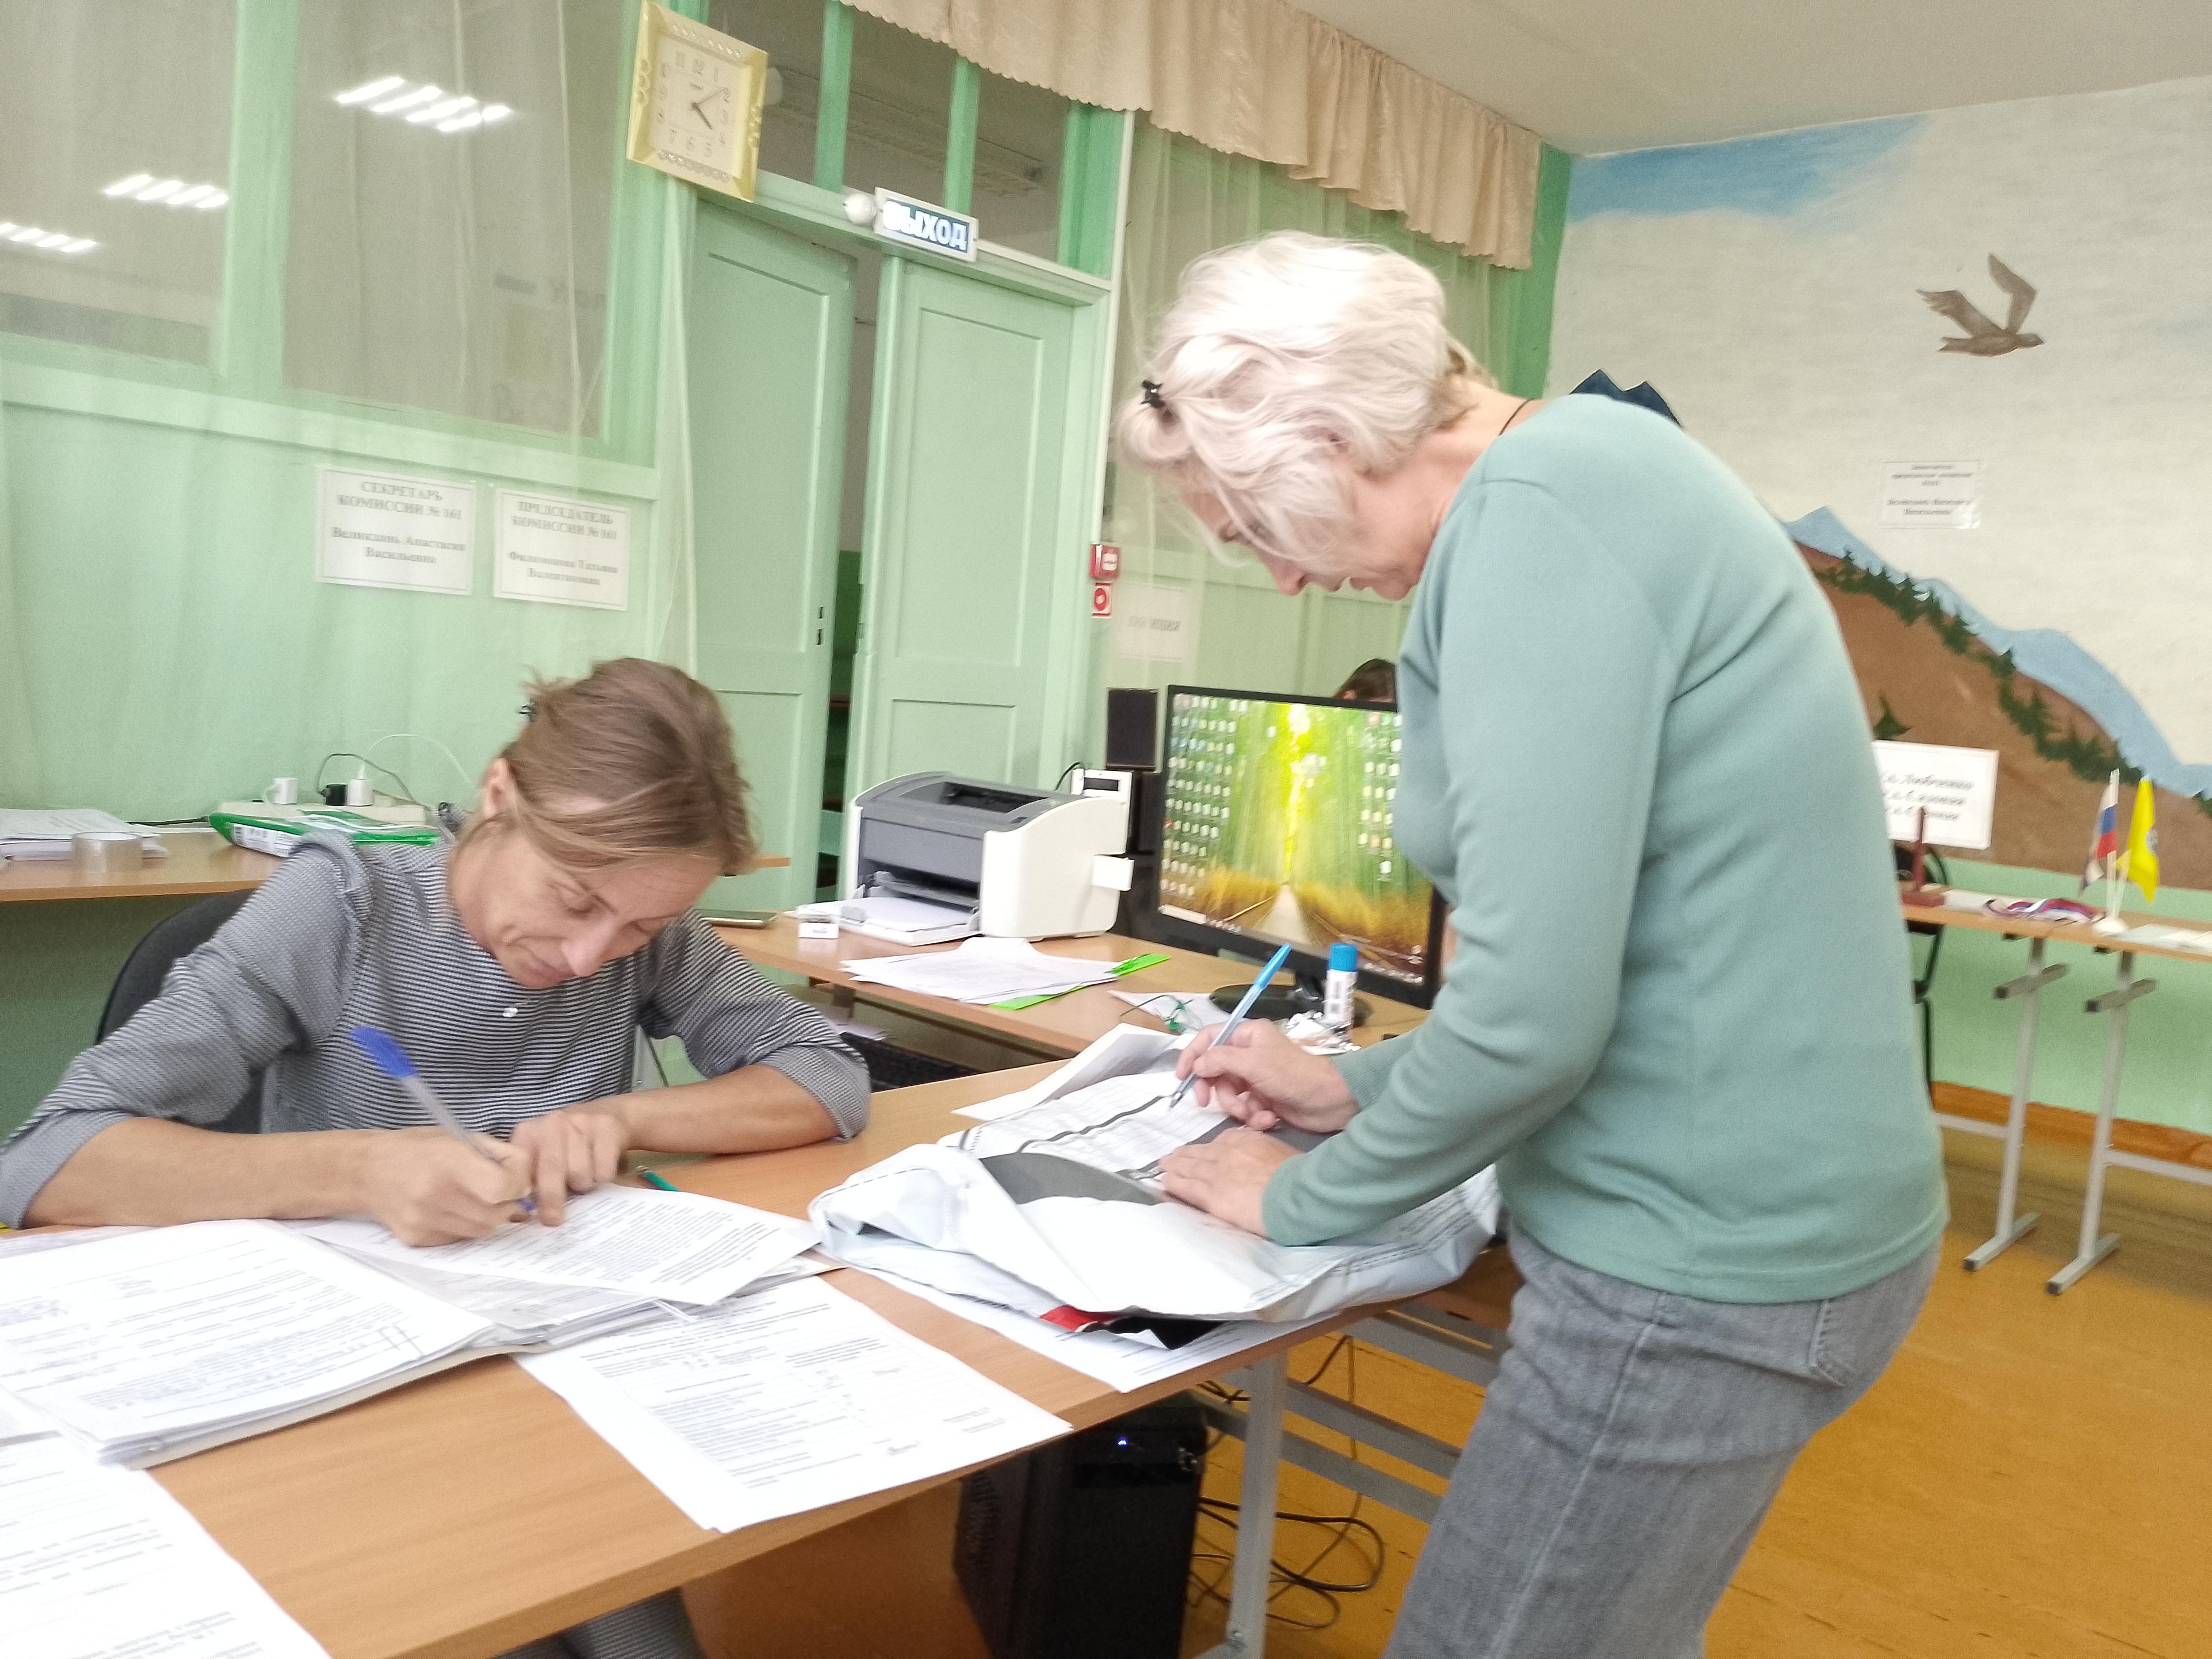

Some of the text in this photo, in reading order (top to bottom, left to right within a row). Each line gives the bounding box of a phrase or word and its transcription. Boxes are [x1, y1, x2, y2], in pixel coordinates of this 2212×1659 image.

[361, 481, 443, 501] СЕКРЕТАРЬ
[337, 494, 423, 515] КОМИССИИ
[517, 501, 613, 524] ПРЕДСЕДАТЕЛЬ
[511, 516, 585, 534] КОМИССИИ
